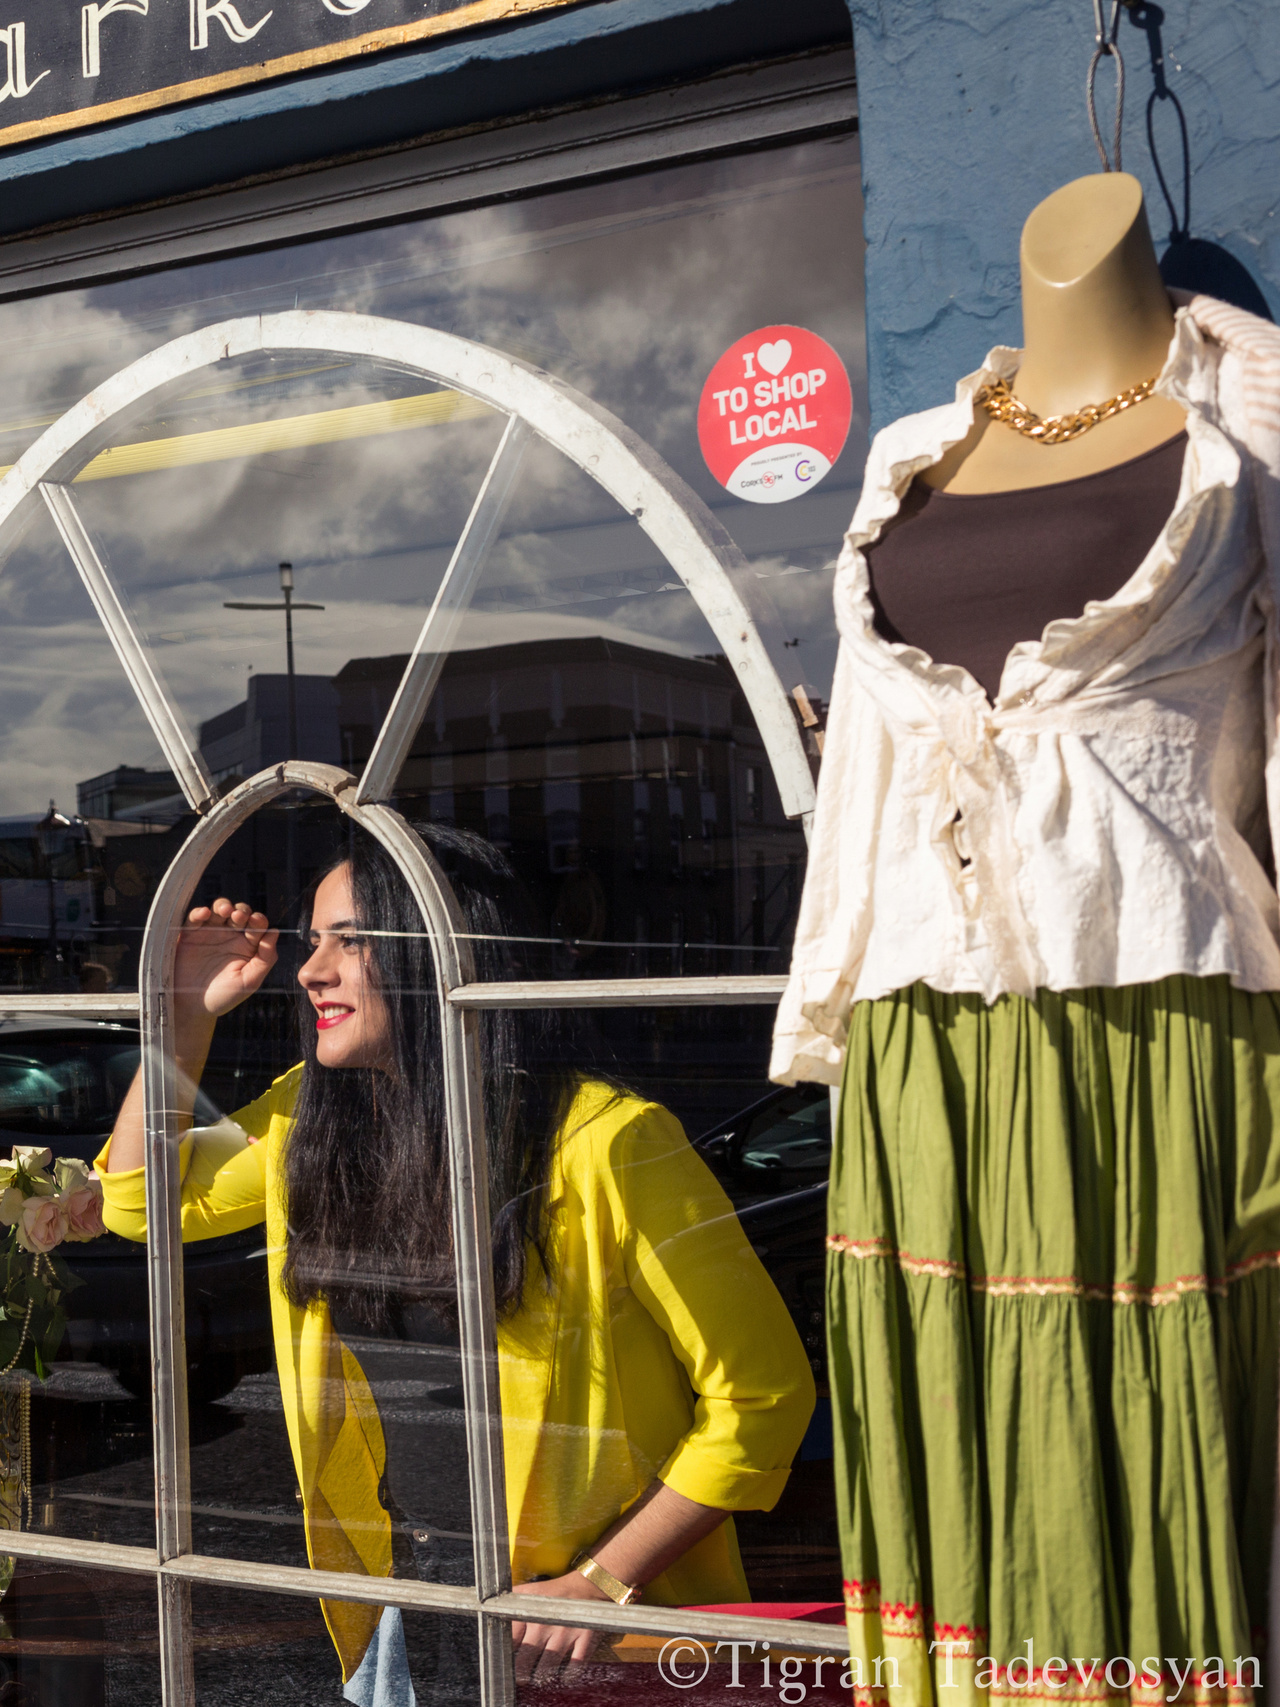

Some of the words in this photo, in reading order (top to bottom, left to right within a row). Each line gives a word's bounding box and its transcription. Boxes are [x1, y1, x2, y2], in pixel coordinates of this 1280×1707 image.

[742, 352, 757, 379] I
[712, 386, 749, 417] TO
[753, 368, 827, 408] SHOP
[728, 404, 818, 446] LOCAL
